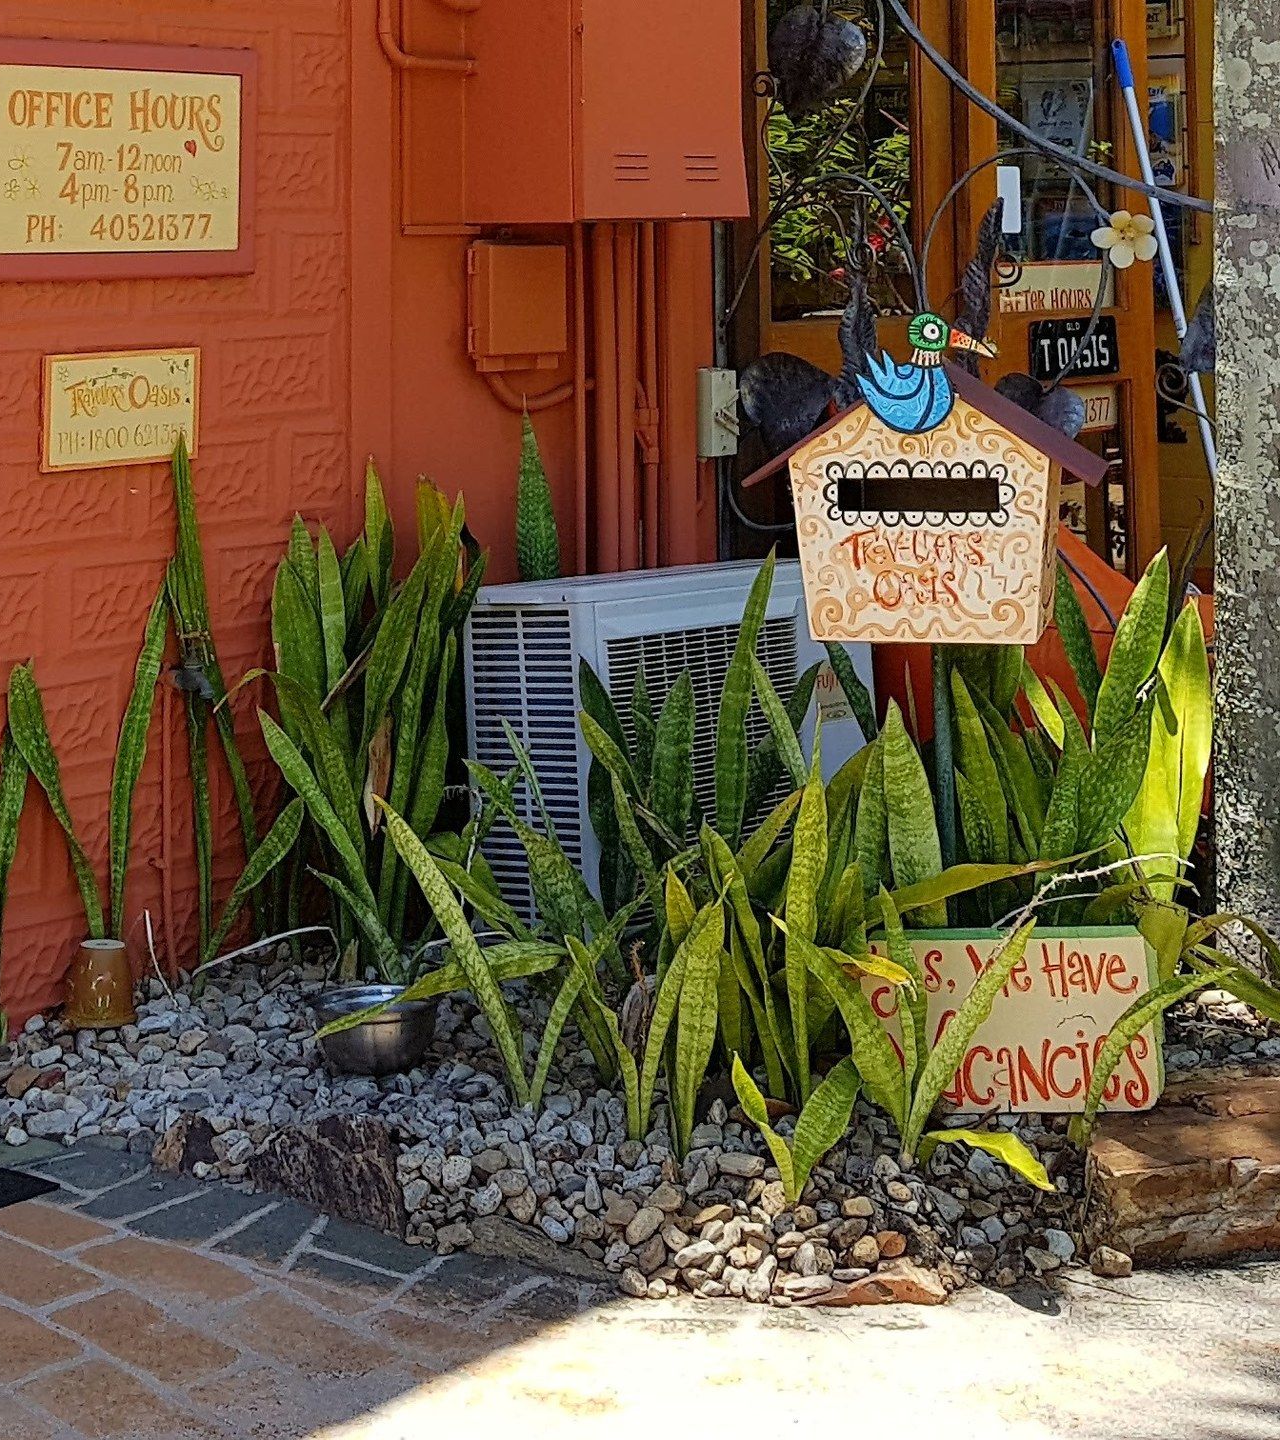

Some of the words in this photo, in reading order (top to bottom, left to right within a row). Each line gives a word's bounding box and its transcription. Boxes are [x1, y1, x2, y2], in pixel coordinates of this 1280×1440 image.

[8, 89, 114, 129] OFFICE
[25, 214, 63, 244] PH:
[90, 213, 212, 242] 40521377
[1050, 287, 1093, 310] HOURS
